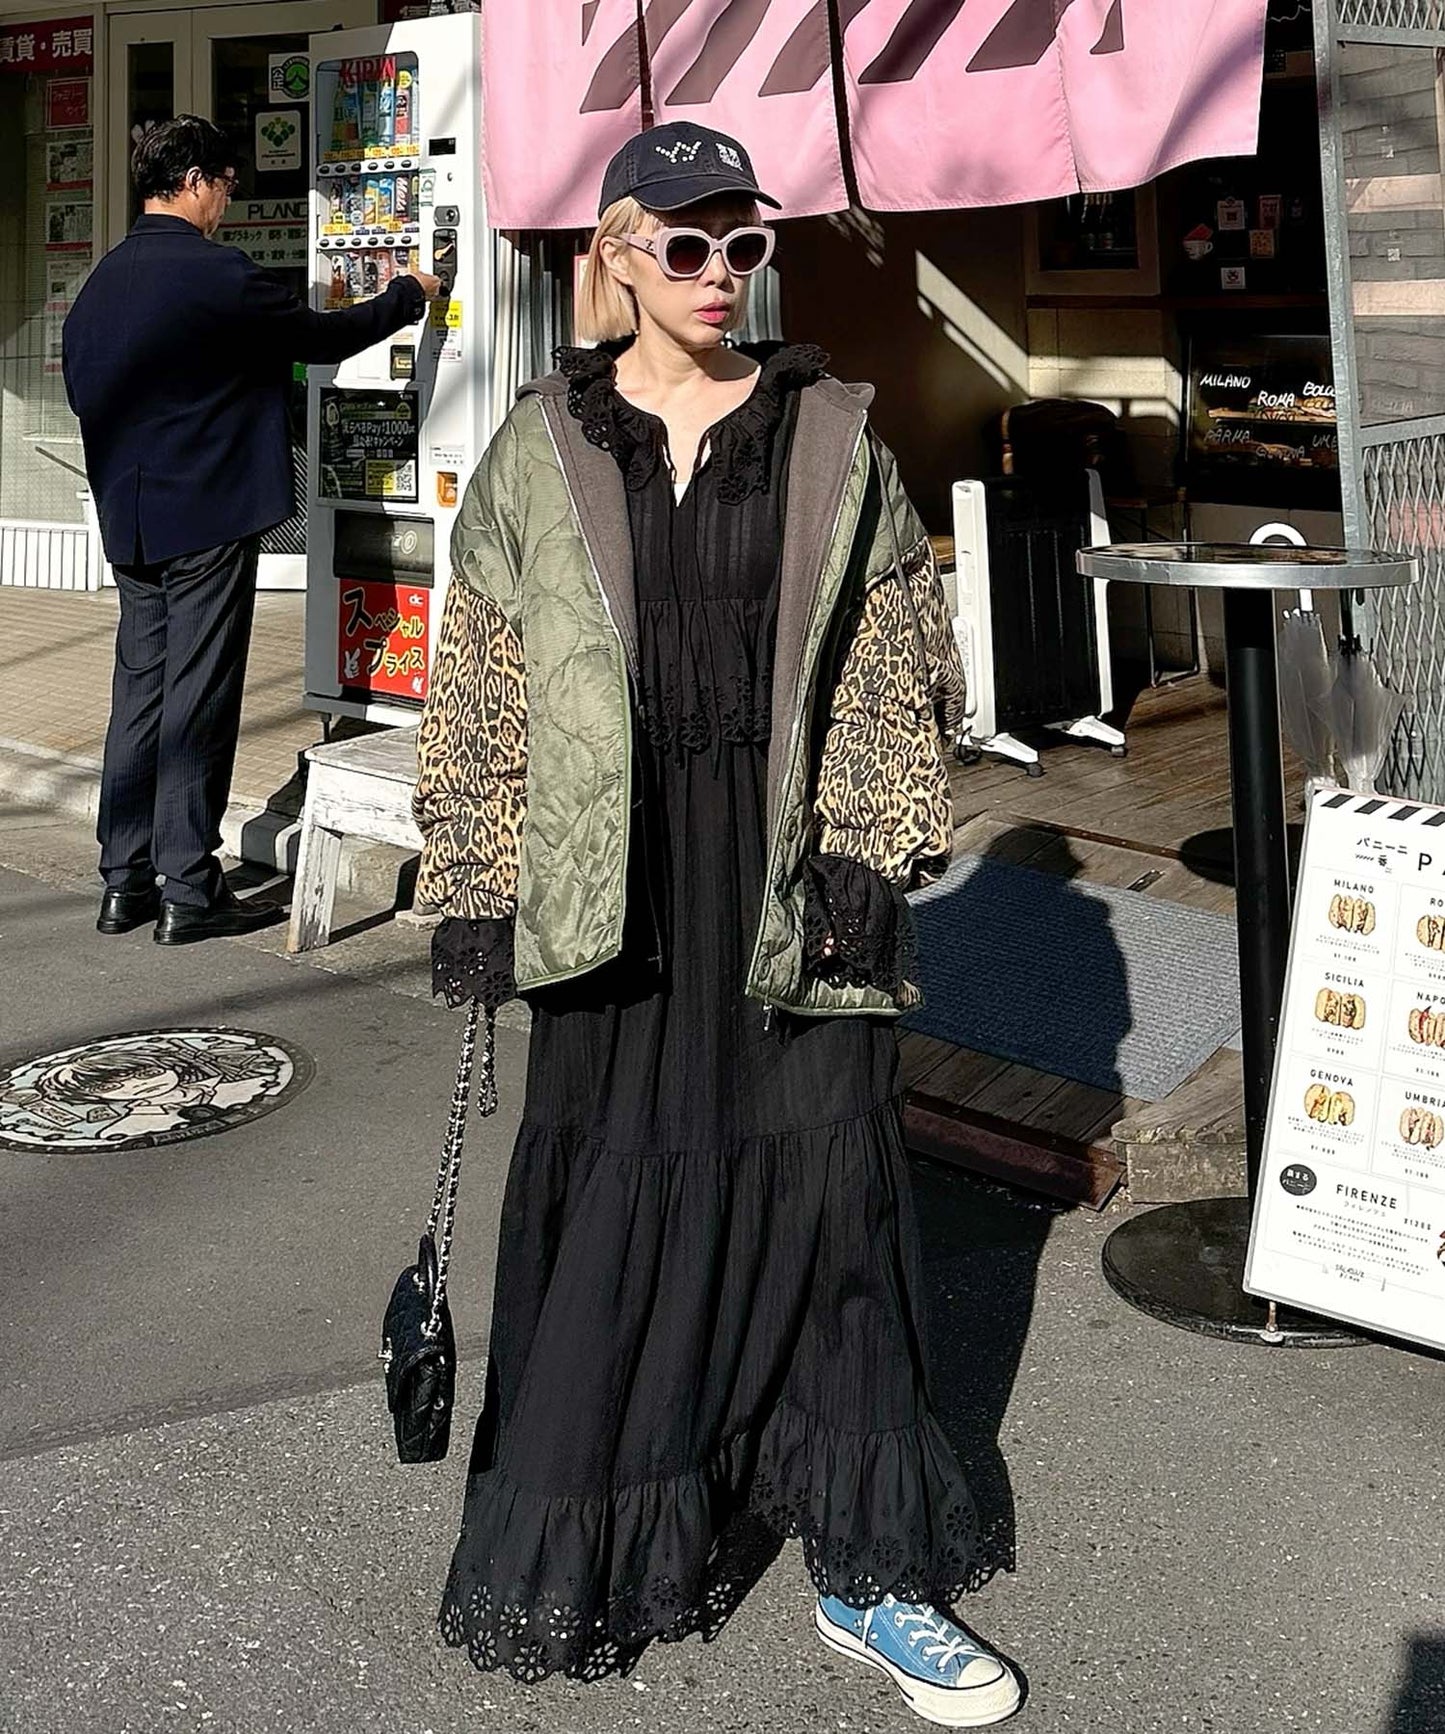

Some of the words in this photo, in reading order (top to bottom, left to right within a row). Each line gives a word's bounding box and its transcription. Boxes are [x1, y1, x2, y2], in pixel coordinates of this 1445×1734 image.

[0, 28, 92, 62] 賃貸・売買
[340, 55, 396, 83] KIRIN
[1200, 372, 1251, 388] MILANO
[1257, 390, 1295, 408] ROMA
[1203, 428, 1250, 445] PARMA
[342, 586, 424, 637] スペシャル
[363, 636, 425, 677] プライス
[1334, 879, 1374, 894] MILANO
[1430, 897, 1444, 907] RO
[1325, 972, 1364, 987] SICILIA
[1416, 991, 1445, 1005] NAPO
[1310, 1069, 1353, 1086] GENOVA
[1336, 1184, 1397, 1209] FIRENZE
